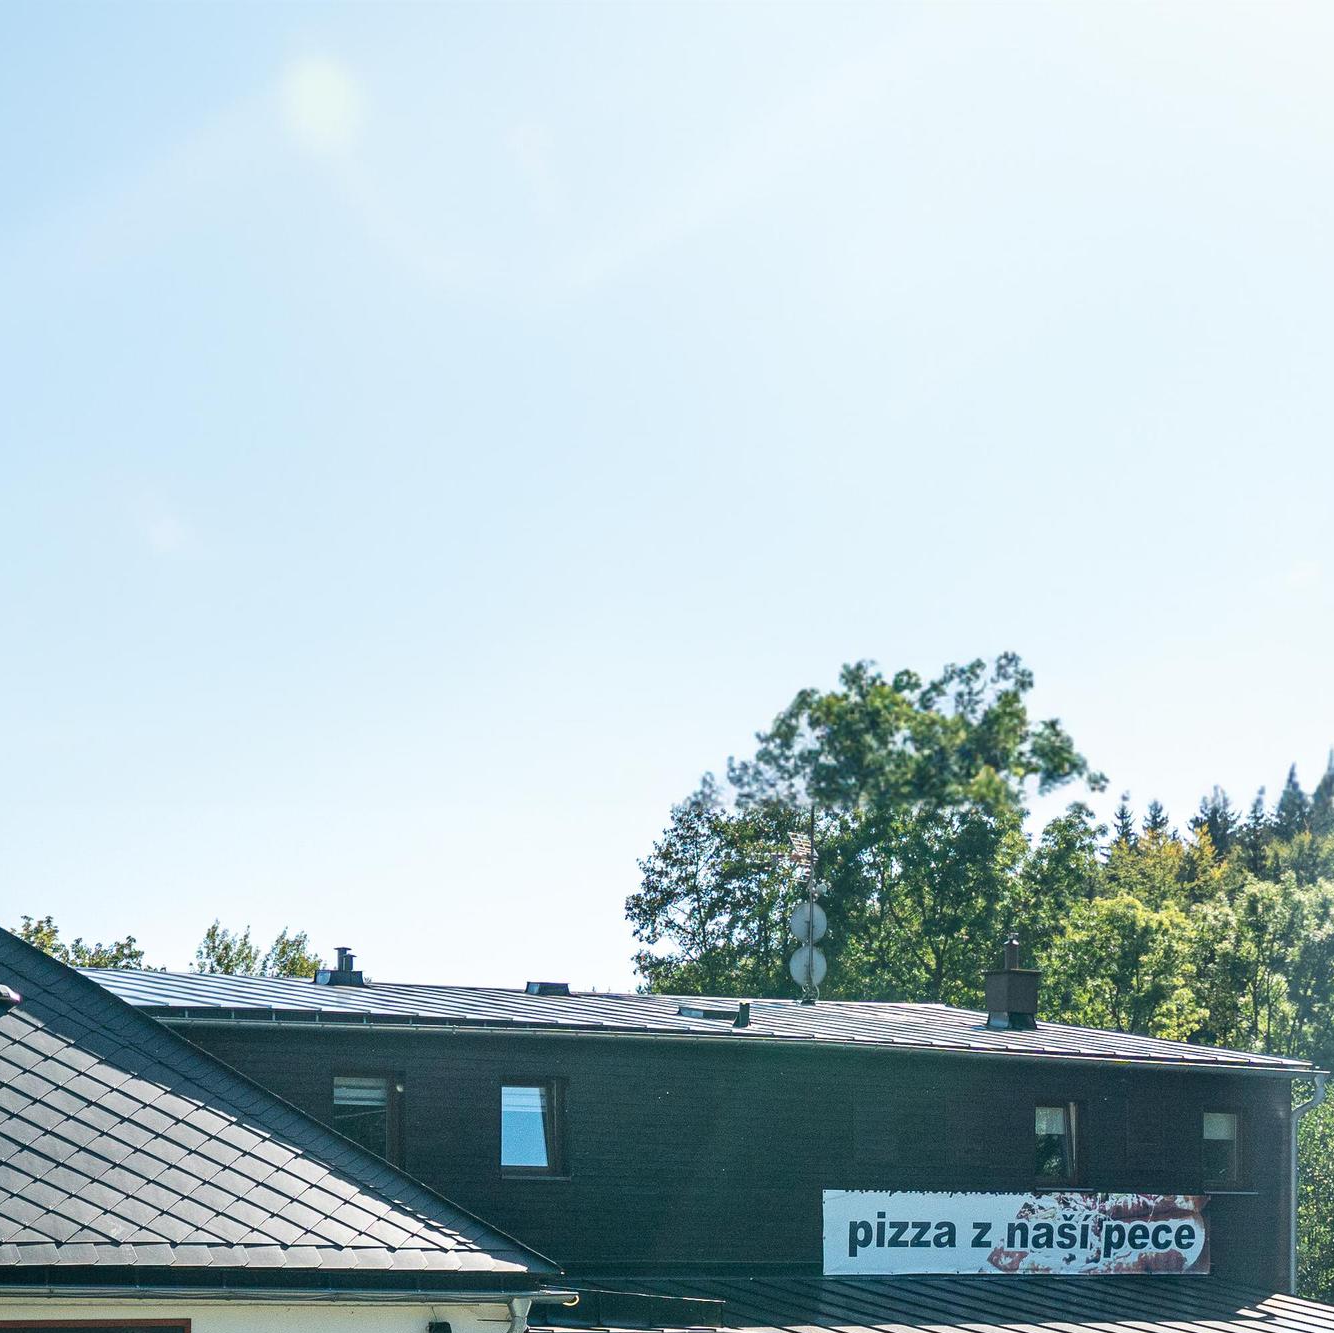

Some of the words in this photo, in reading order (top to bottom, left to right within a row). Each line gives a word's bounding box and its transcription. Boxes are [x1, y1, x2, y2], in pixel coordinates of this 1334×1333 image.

[848, 1211, 957, 1258] pizza
[971, 1221, 993, 1248] z
[1006, 1213, 1091, 1250] naší
[1102, 1222, 1196, 1259] pece
